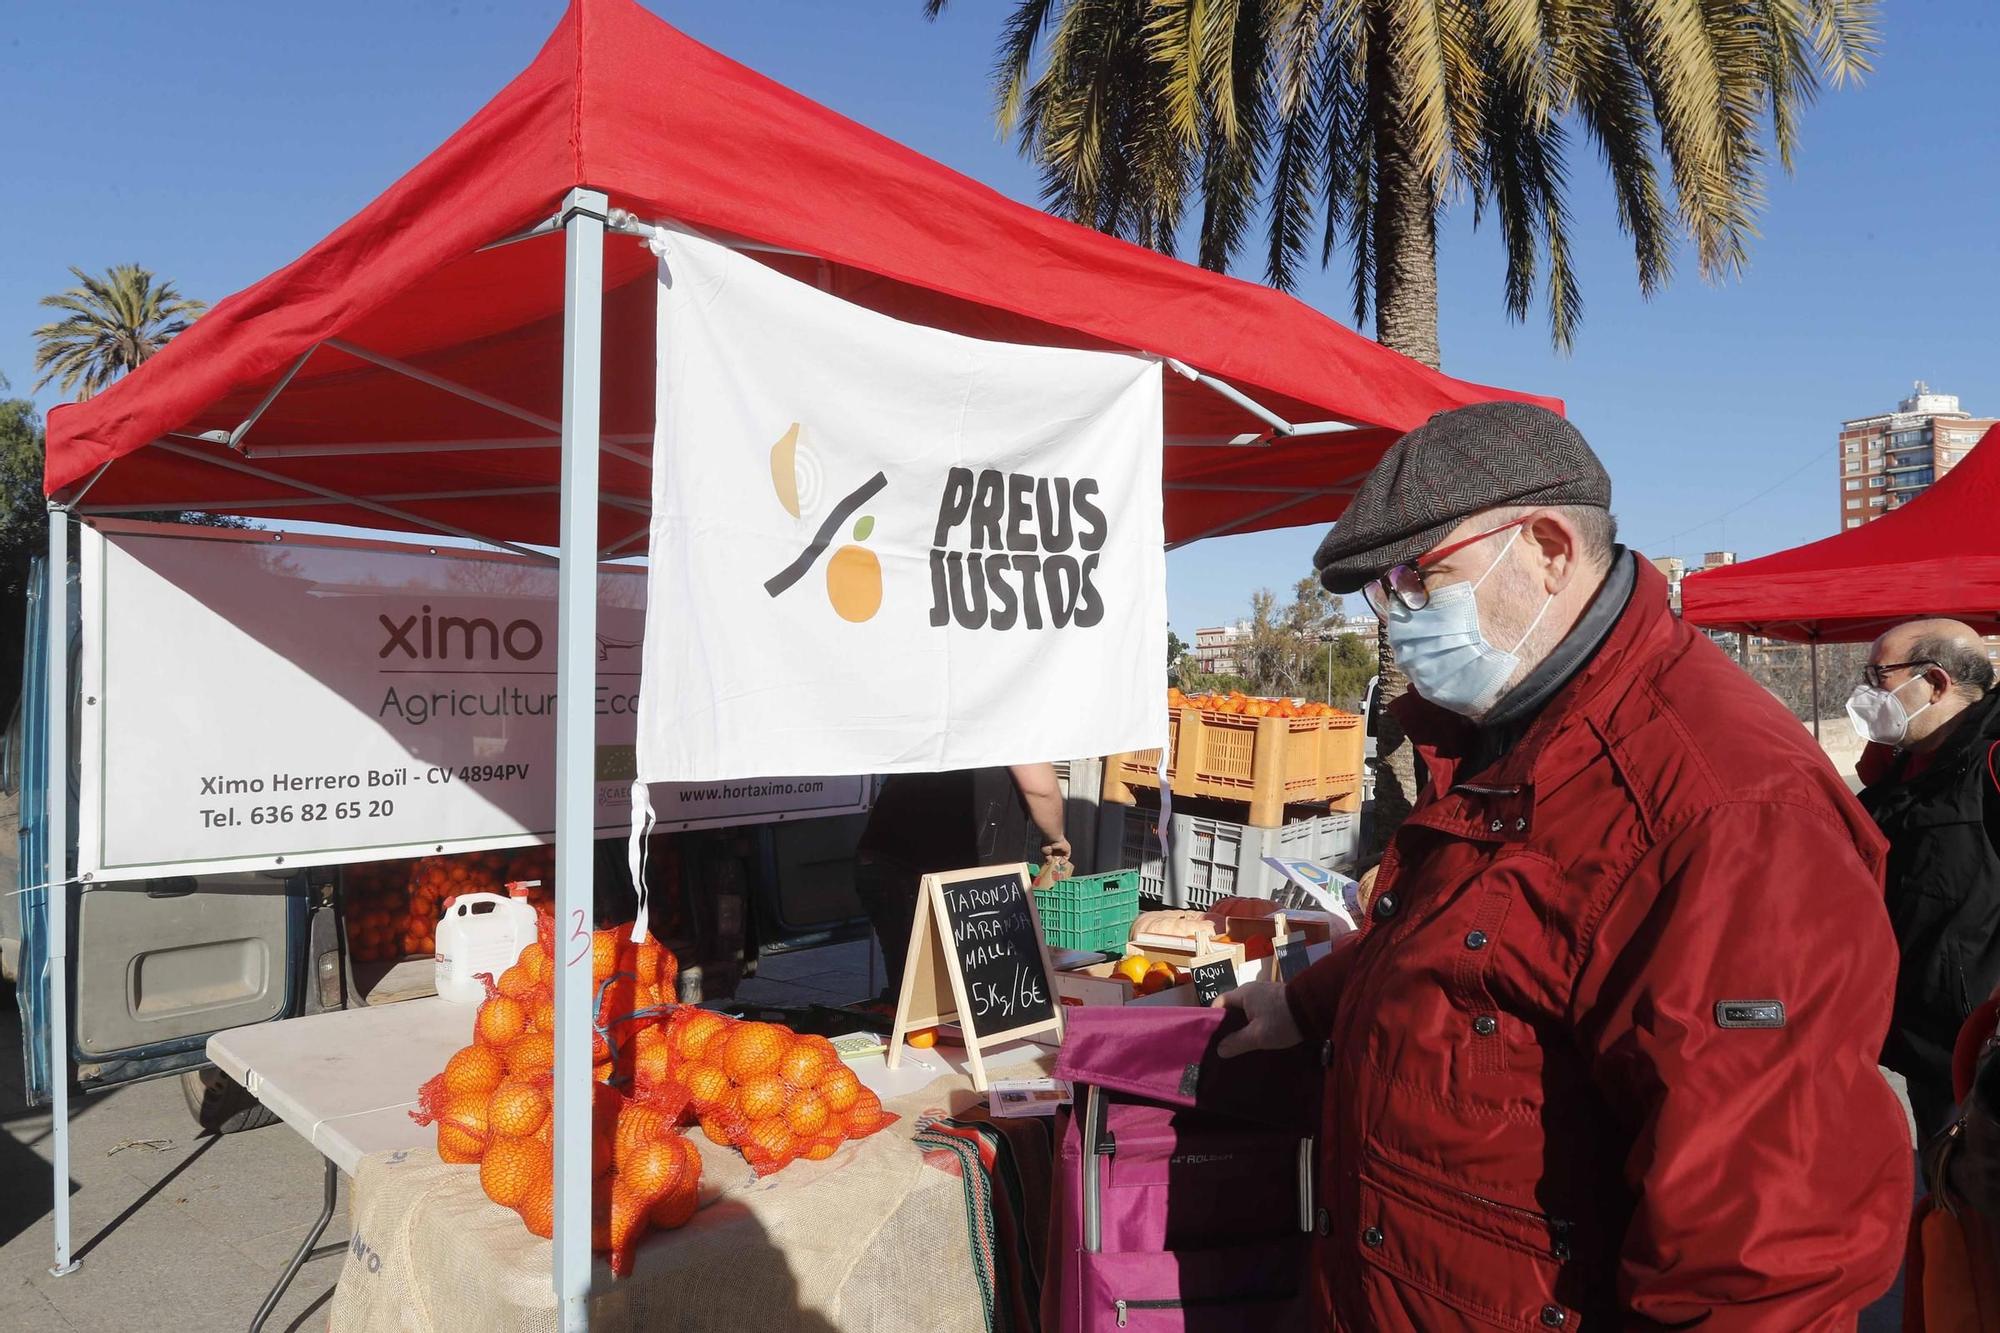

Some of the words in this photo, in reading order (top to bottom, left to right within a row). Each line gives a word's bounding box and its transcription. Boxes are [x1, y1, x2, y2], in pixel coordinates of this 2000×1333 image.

[933, 466, 1108, 554] PREUS
[929, 549, 1105, 631] JUSTOS
[379, 605, 543, 661] ximo
[379, 686, 558, 725] Agricultur
[594, 687, 639, 715] Eco
[200, 776, 264, 795] Ximo
[272, 773, 360, 792] Herrero
[367, 768, 407, 787] Boïl
[427, 767, 453, 785] CV
[459, 764, 529, 783] 4894PV
[680, 781, 824, 802] www.hortaximo.com
[200, 807, 241, 828] Tel.
[250, 805, 294, 825] 636
[301, 803, 328, 822] 82
[335, 801, 361, 820] 65
[368, 800, 394, 818] 20
[944, 882, 1021, 912] TARONJA
[566, 909, 591, 967] 3
[954, 912, 1031, 947] NARANJA
[965, 940, 1017, 972] MALLA
